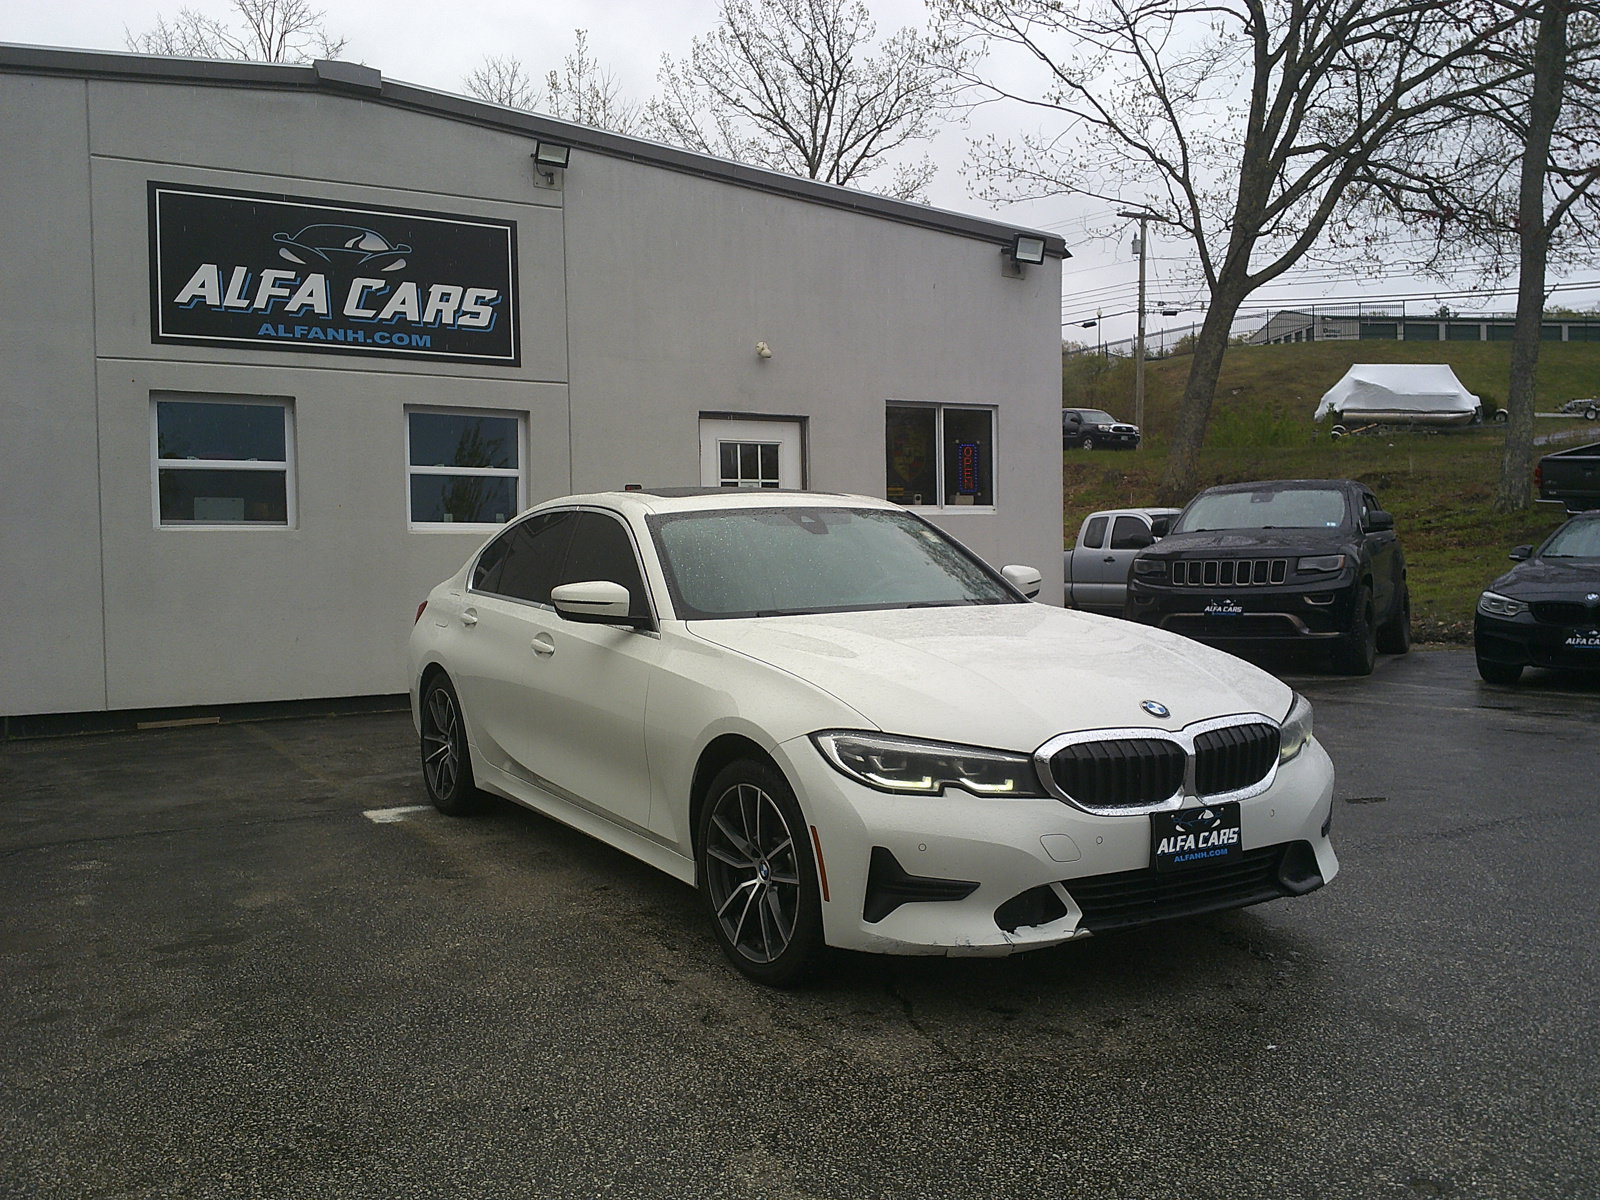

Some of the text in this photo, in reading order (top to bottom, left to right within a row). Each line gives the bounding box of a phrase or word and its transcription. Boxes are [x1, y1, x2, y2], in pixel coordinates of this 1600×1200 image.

[174, 263, 501, 331] ALFA CARS
[257, 322, 431, 348] ALFANH.COM
[963, 446, 973, 489] OPEN
[1157, 827, 1239, 855] ALFA CARS
[1174, 848, 1227, 862] ALFANH.COM
